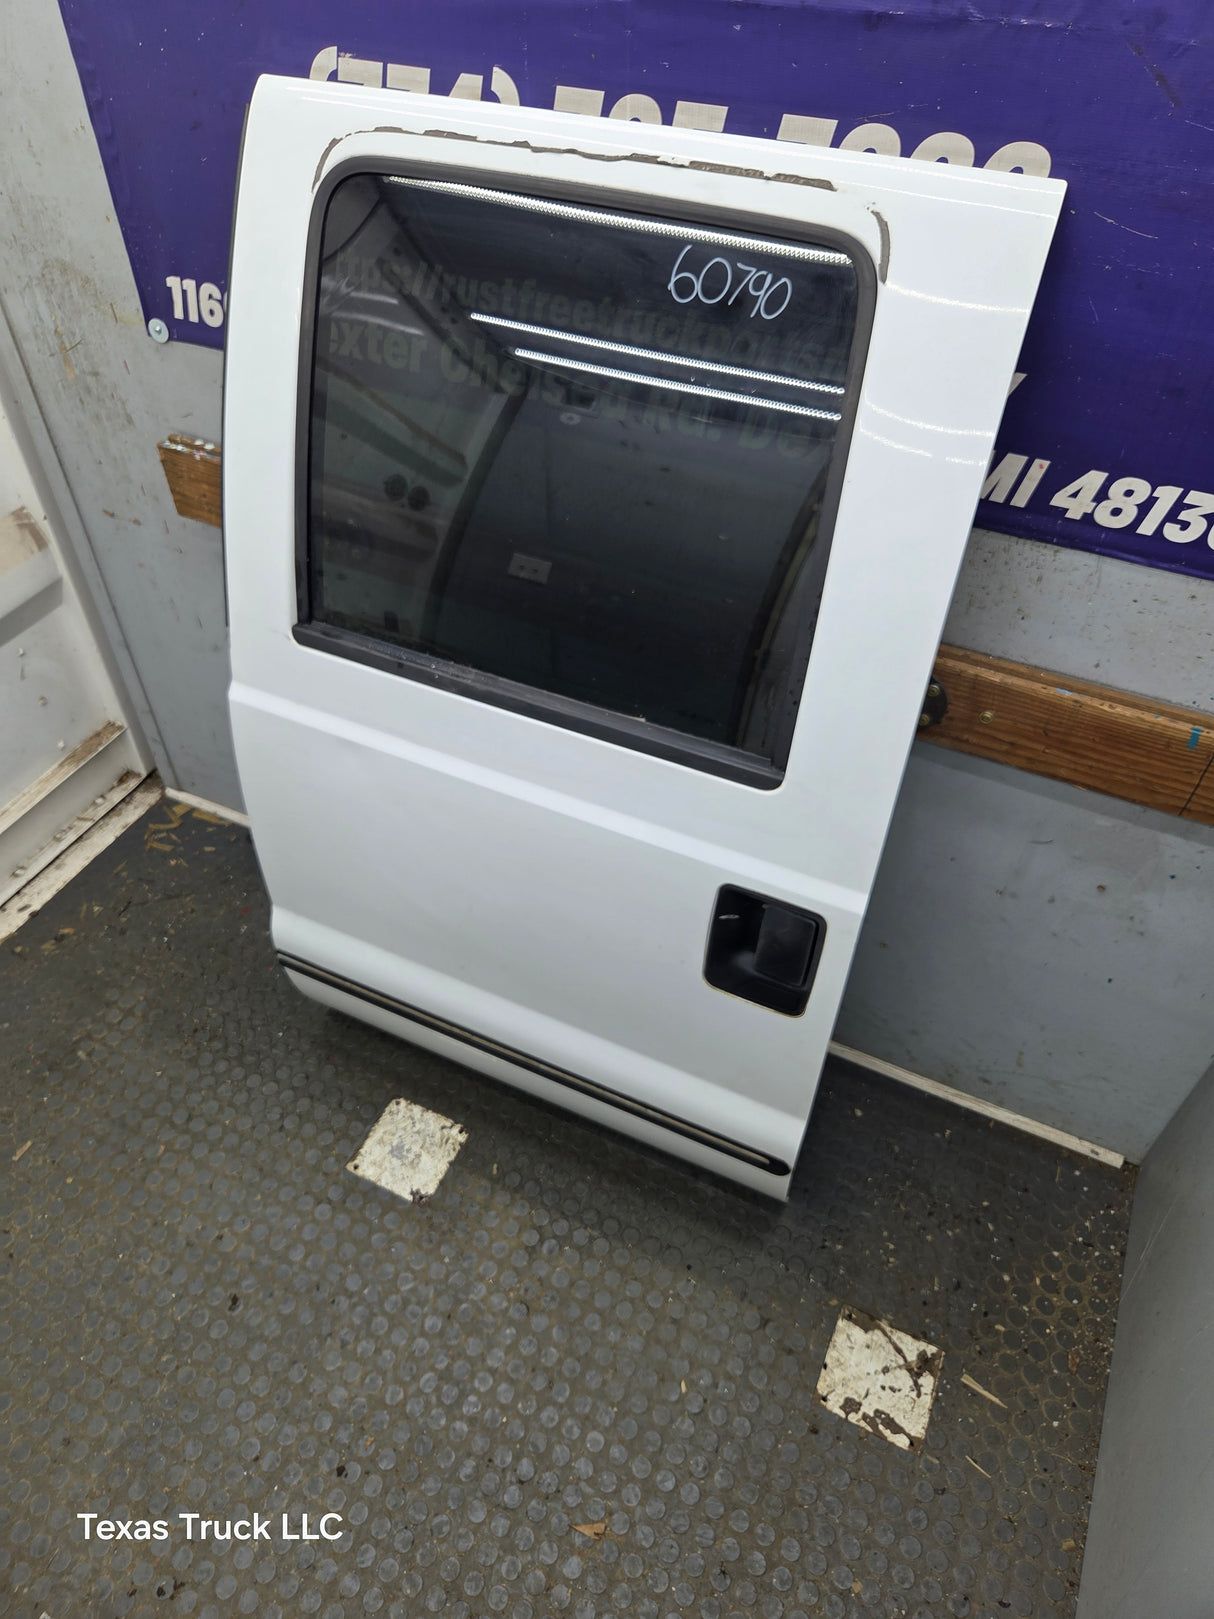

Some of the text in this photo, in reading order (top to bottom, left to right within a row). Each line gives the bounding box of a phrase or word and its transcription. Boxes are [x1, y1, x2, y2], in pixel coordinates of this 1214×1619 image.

[668, 245, 792, 319] 60790
[166, 275, 228, 328] 116
[329, 320, 429, 373] exter
[1049, 470, 1214, 551] 4813
